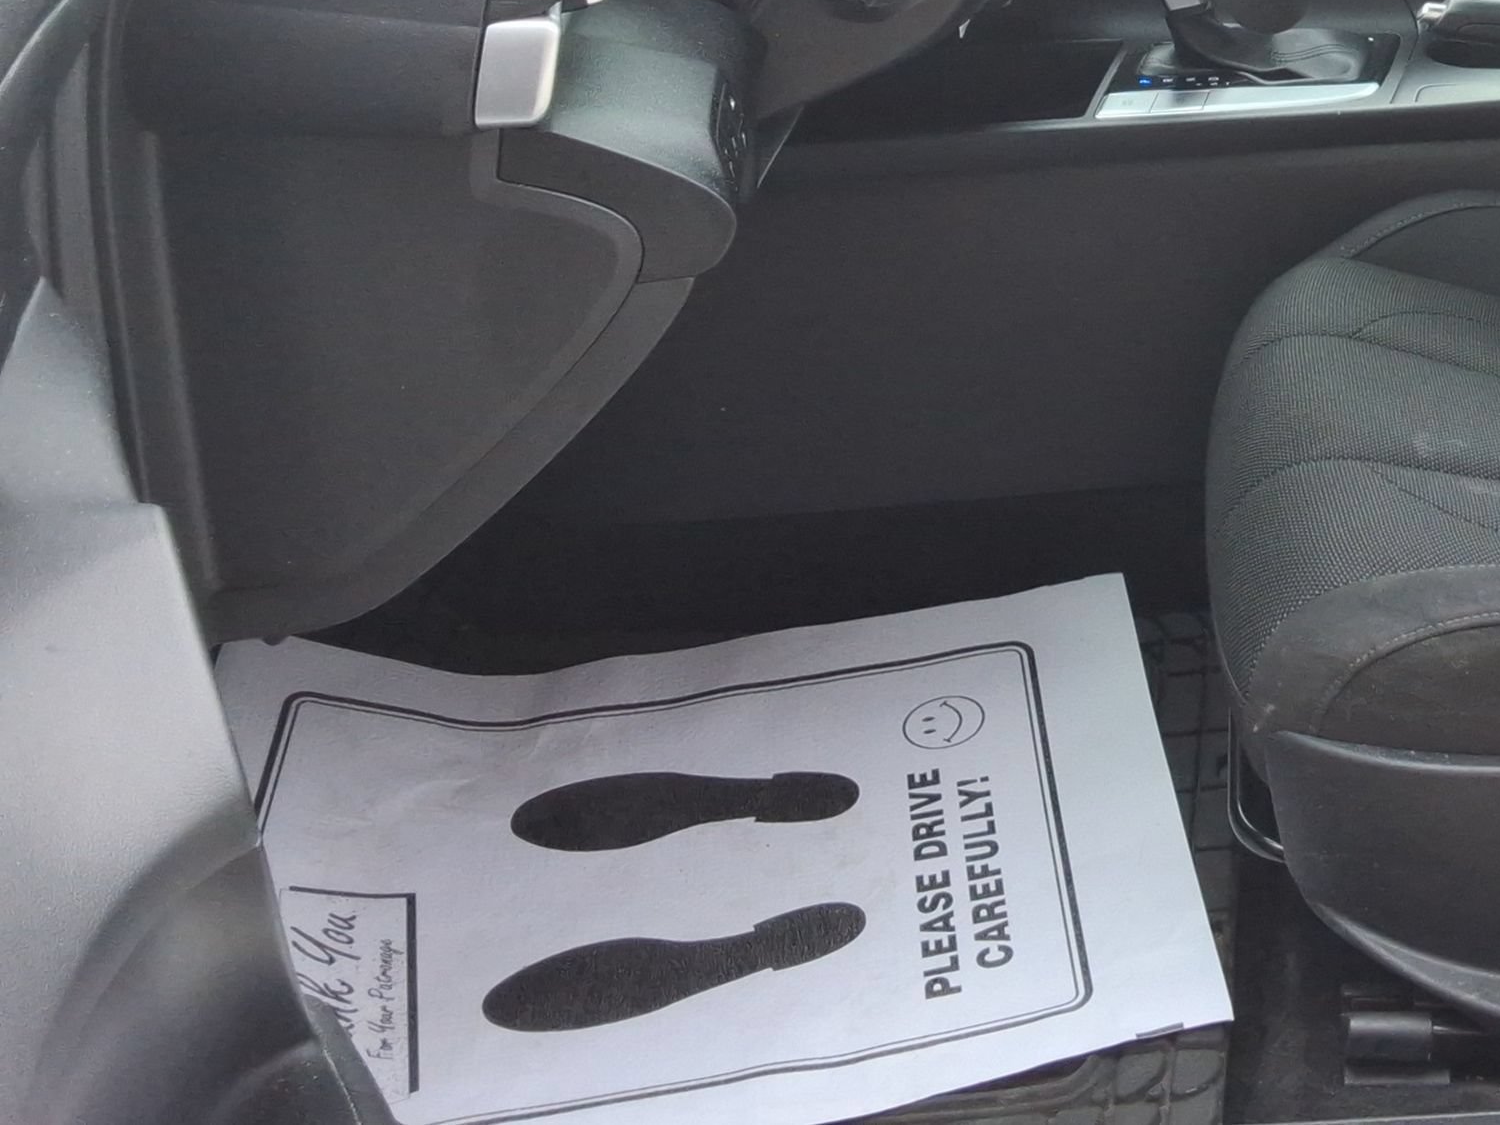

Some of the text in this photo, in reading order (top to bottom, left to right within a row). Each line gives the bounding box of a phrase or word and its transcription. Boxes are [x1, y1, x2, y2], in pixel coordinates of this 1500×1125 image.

[906, 767, 963, 1000] PLEASE DRIVE
[956, 775, 1014, 969] CAREFULLY!
[290, 912, 361, 966] You
[367, 938, 404, 1001] Patronage
[366, 1037, 394, 1060] For
